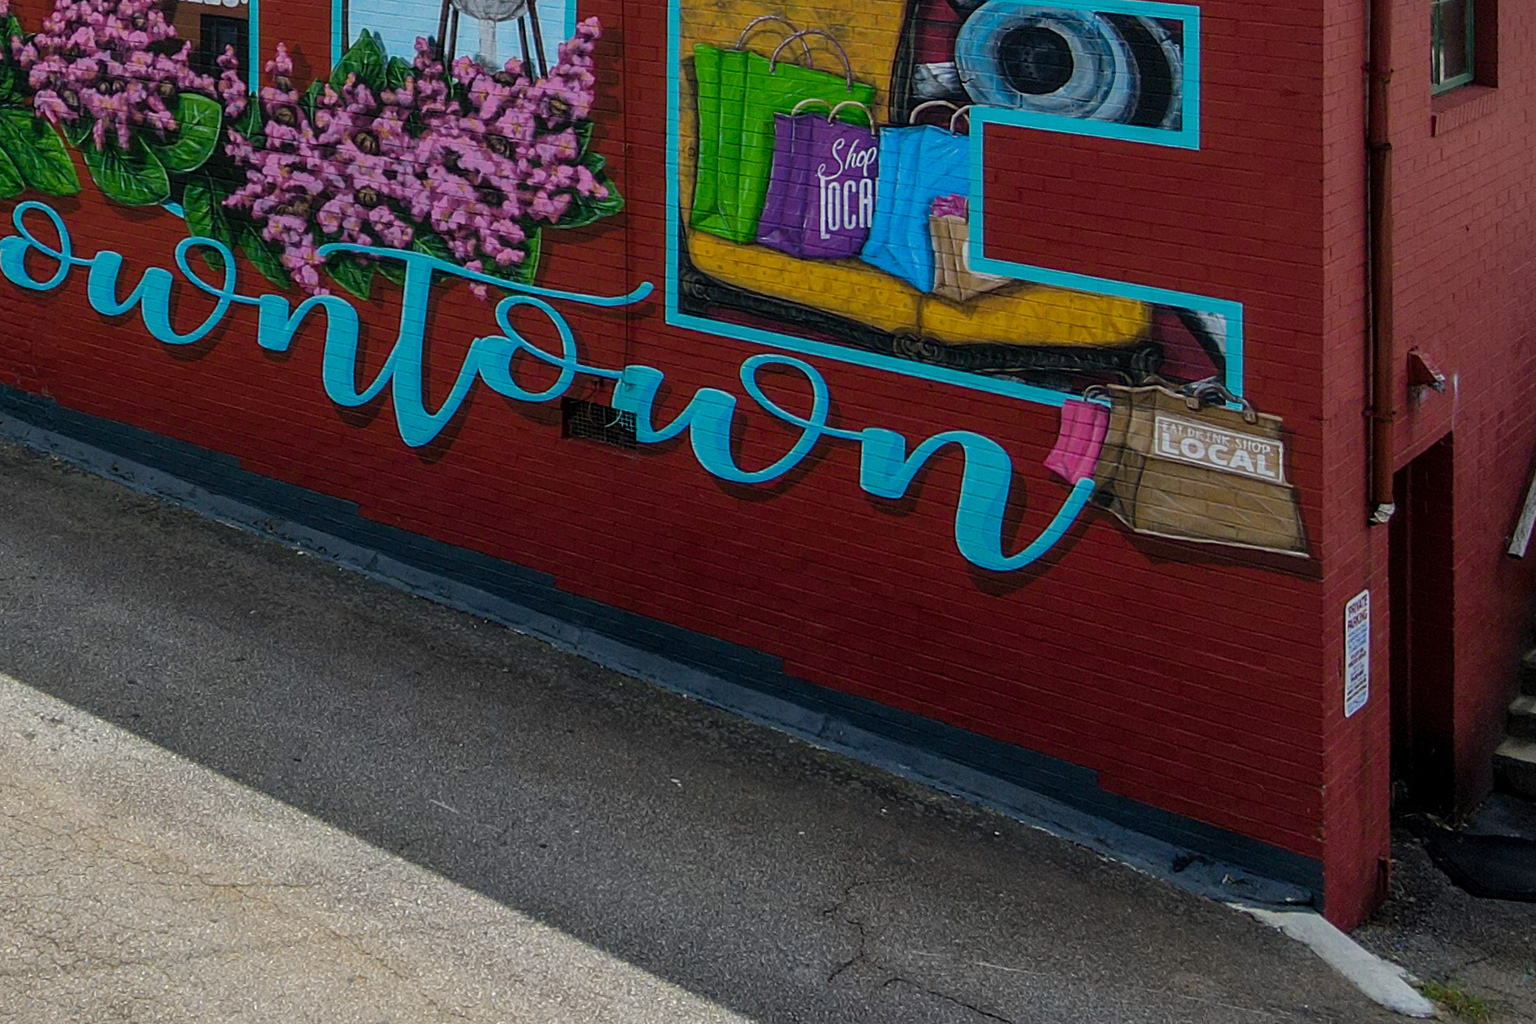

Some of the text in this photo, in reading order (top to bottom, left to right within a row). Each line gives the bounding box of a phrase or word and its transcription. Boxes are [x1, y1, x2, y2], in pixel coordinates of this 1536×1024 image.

[815, 138, 878, 180] Shop
[820, 176, 880, 240] LOCA
[1162, 433, 1276, 476] LOCAL
